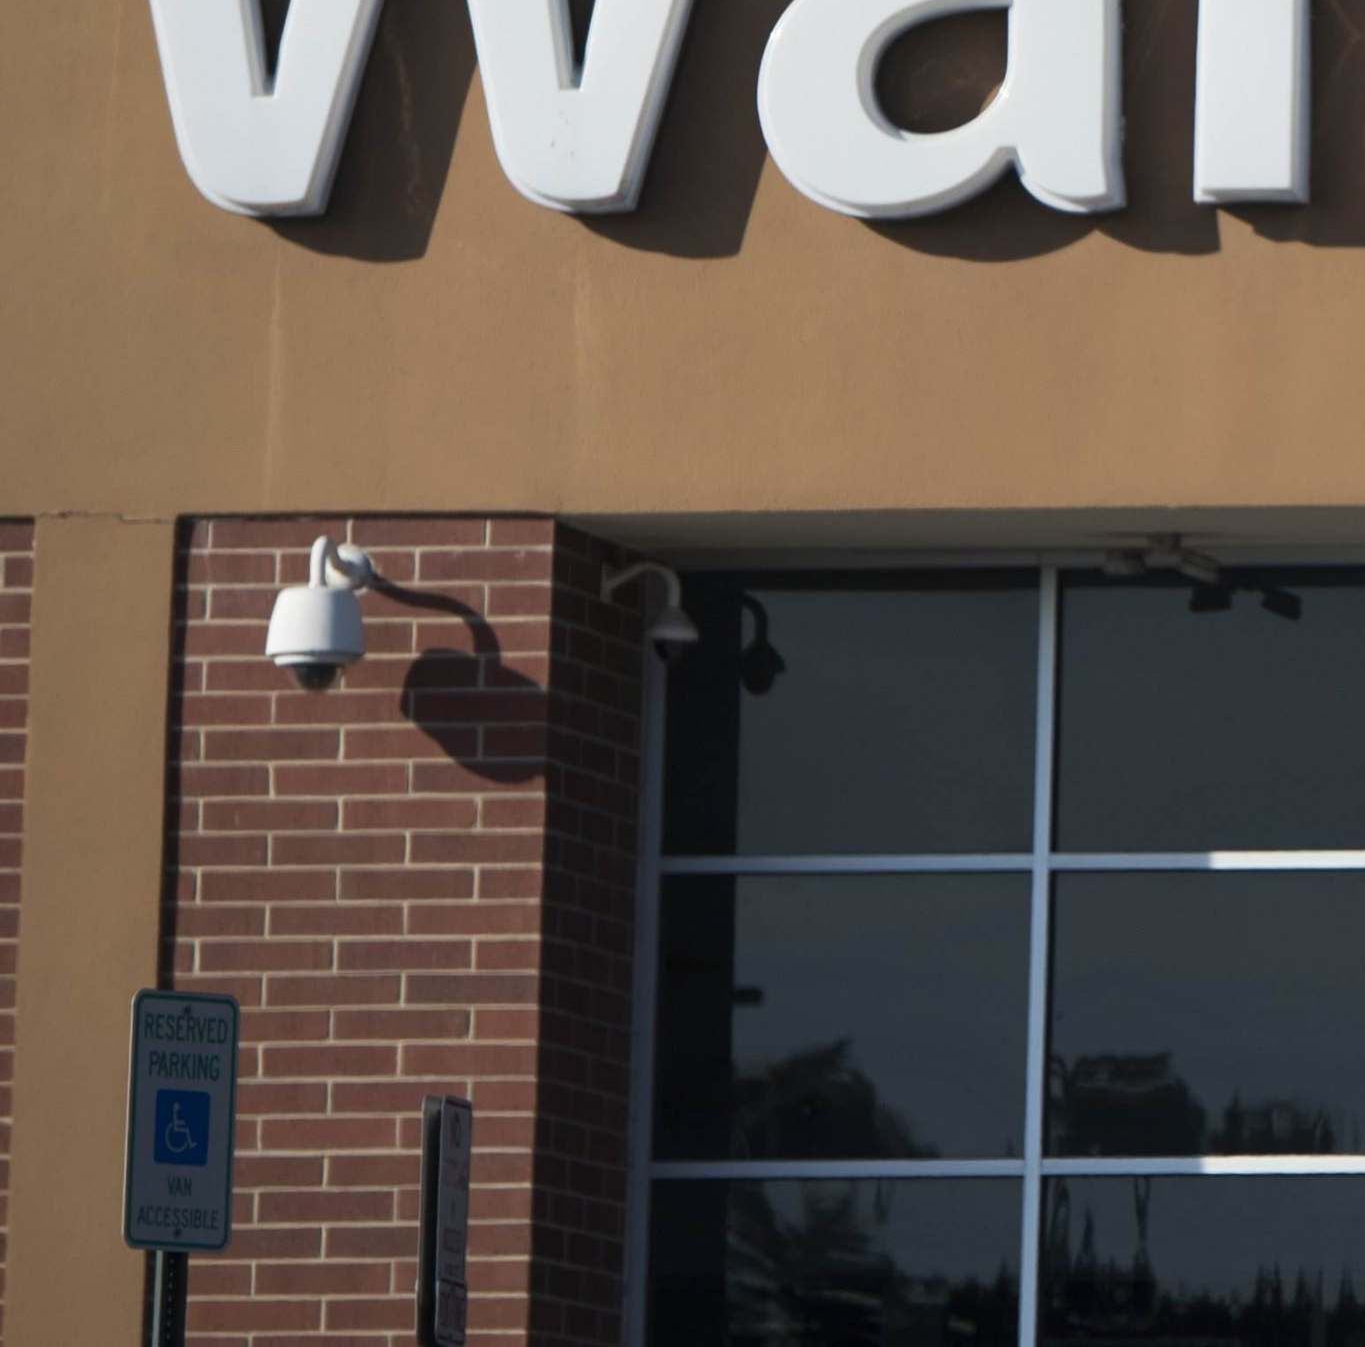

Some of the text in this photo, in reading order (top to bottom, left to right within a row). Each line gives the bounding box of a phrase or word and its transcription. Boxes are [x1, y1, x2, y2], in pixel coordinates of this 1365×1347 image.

[143, 1013, 228, 1044] RESERVED
[148, 1051, 221, 1081] PARKING
[167, 1176, 193, 1197] VAN
[137, 1206, 219, 1230] ACCESSIBLE
